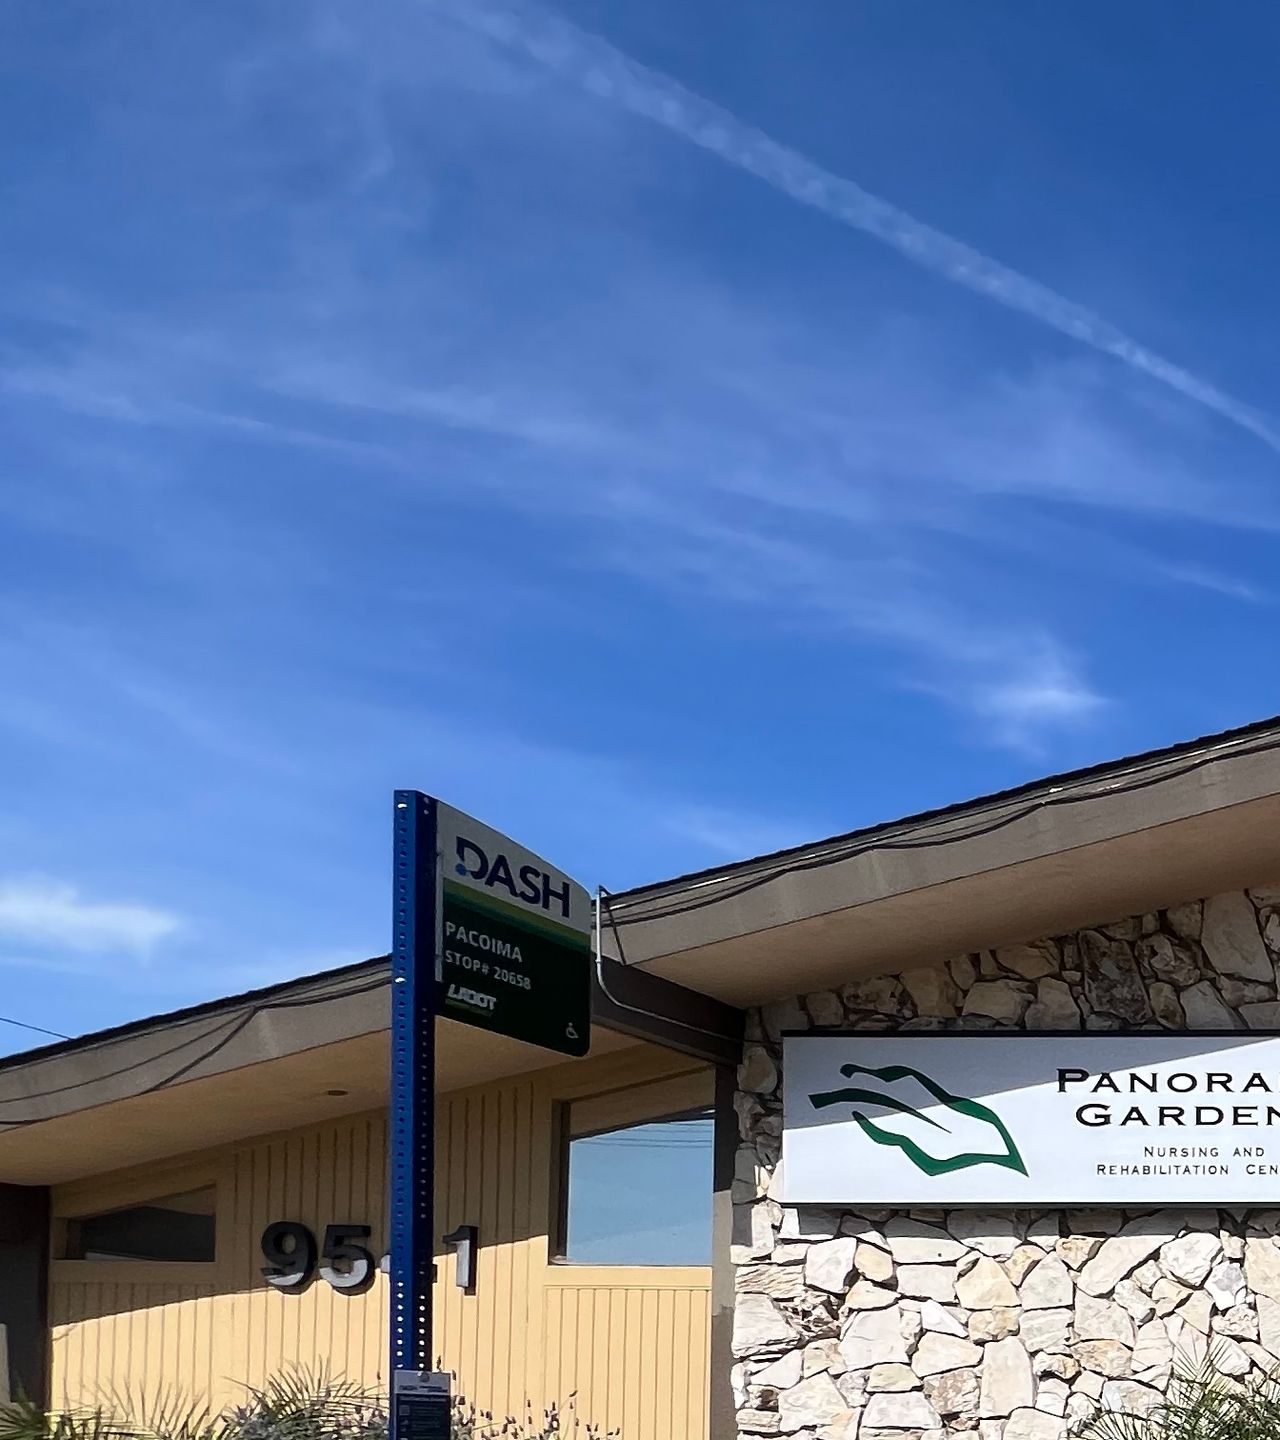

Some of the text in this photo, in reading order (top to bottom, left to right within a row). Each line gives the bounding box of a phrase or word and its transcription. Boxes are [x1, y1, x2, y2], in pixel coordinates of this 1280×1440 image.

[455, 836, 570, 918] DASH
[445, 921, 523, 963] PACOIMA
[445, 950, 532, 990] STOP# 20658
[1097, 1163, 1229, 1176] REHABILITATION
[1144, 1146, 1265, 1158] NURSING AND
[261, 1221, 478, 1296] 951
